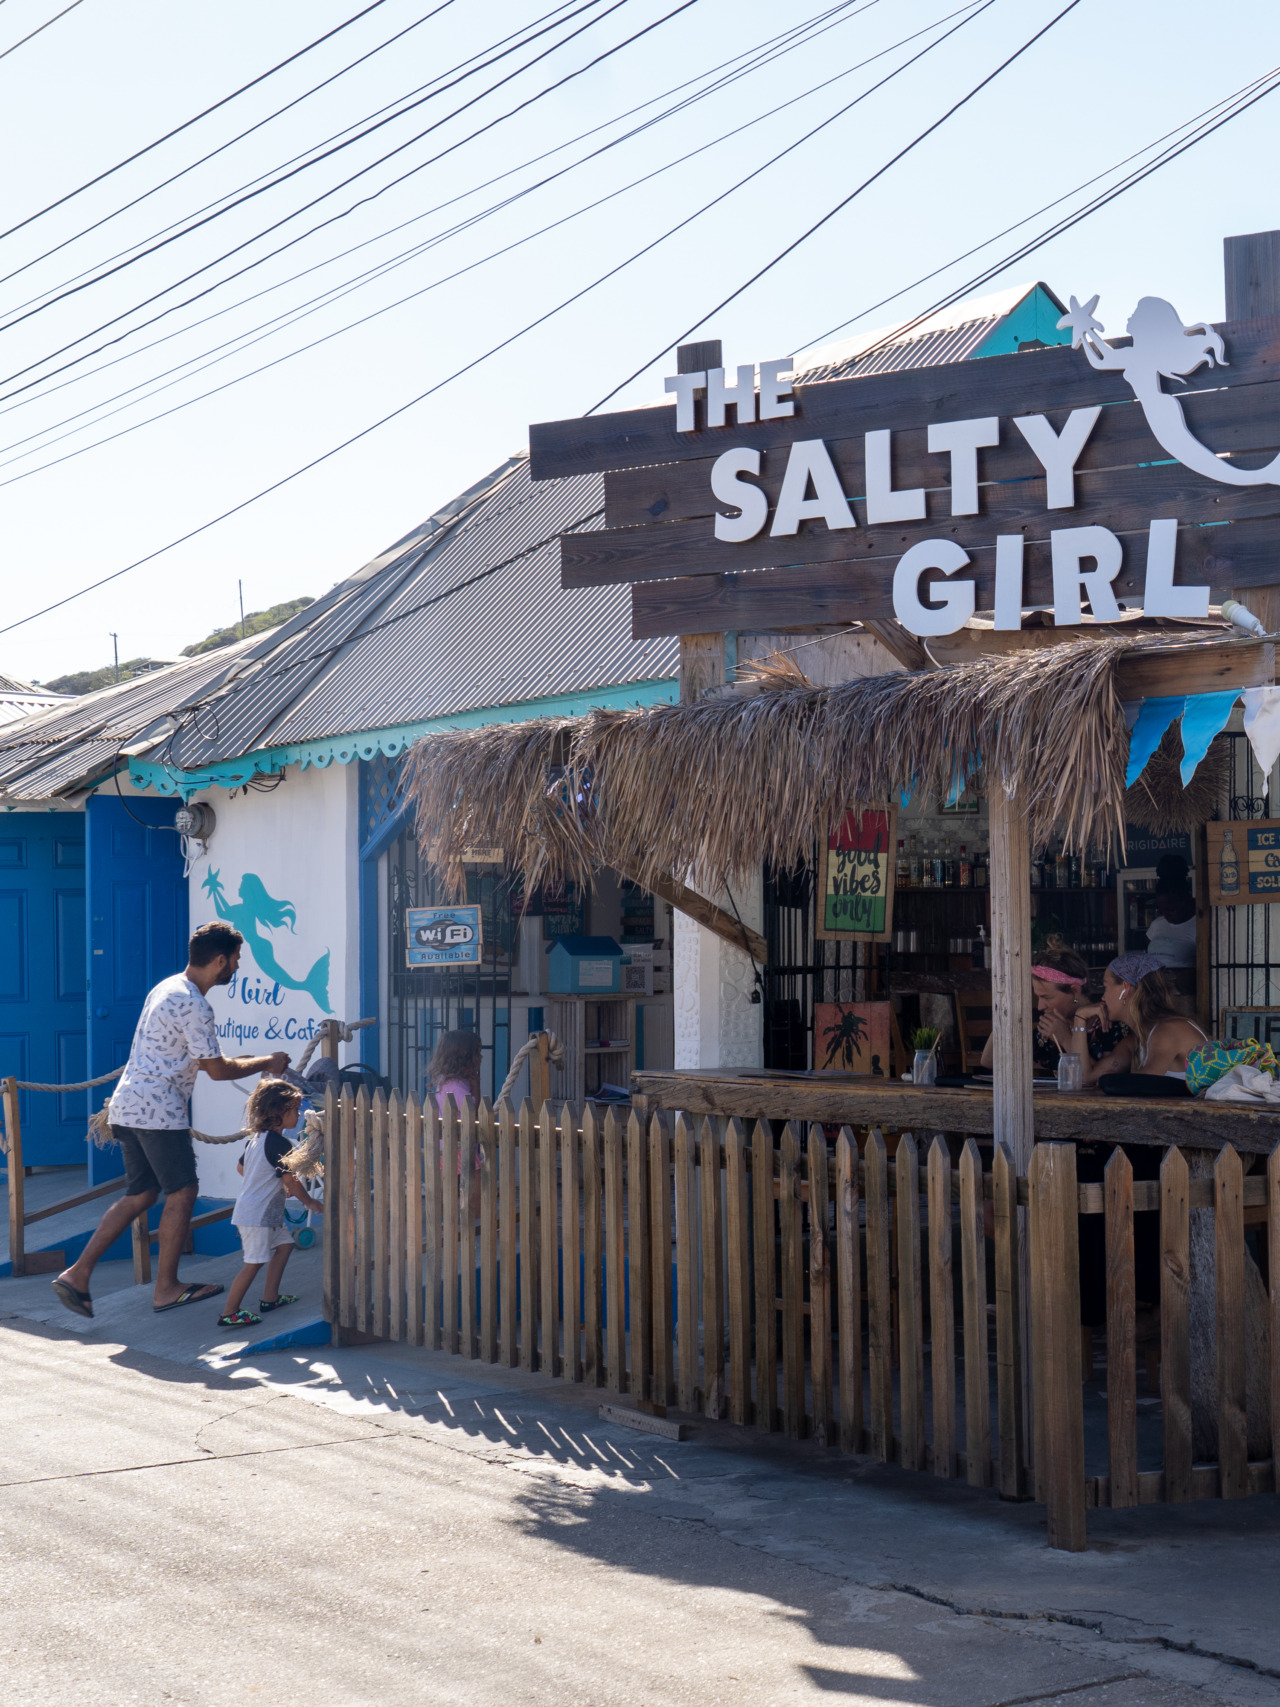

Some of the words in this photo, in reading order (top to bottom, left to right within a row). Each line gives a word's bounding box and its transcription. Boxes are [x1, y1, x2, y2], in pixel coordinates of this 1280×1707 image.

[663, 357, 796, 433] THE
[712, 406, 1103, 543] SALTY
[892, 518, 1210, 638] GIRL
[836, 832, 882, 873] good
[1127, 838, 1187, 851] RIGIDAIRE
[1257, 833, 1275, 846] ICE
[832, 864, 881, 896] vibes
[832, 892, 872, 928] only
[421, 951, 471, 960] Available
[215, 1017, 259, 1046] outique
[264, 1016, 284, 1040] &
